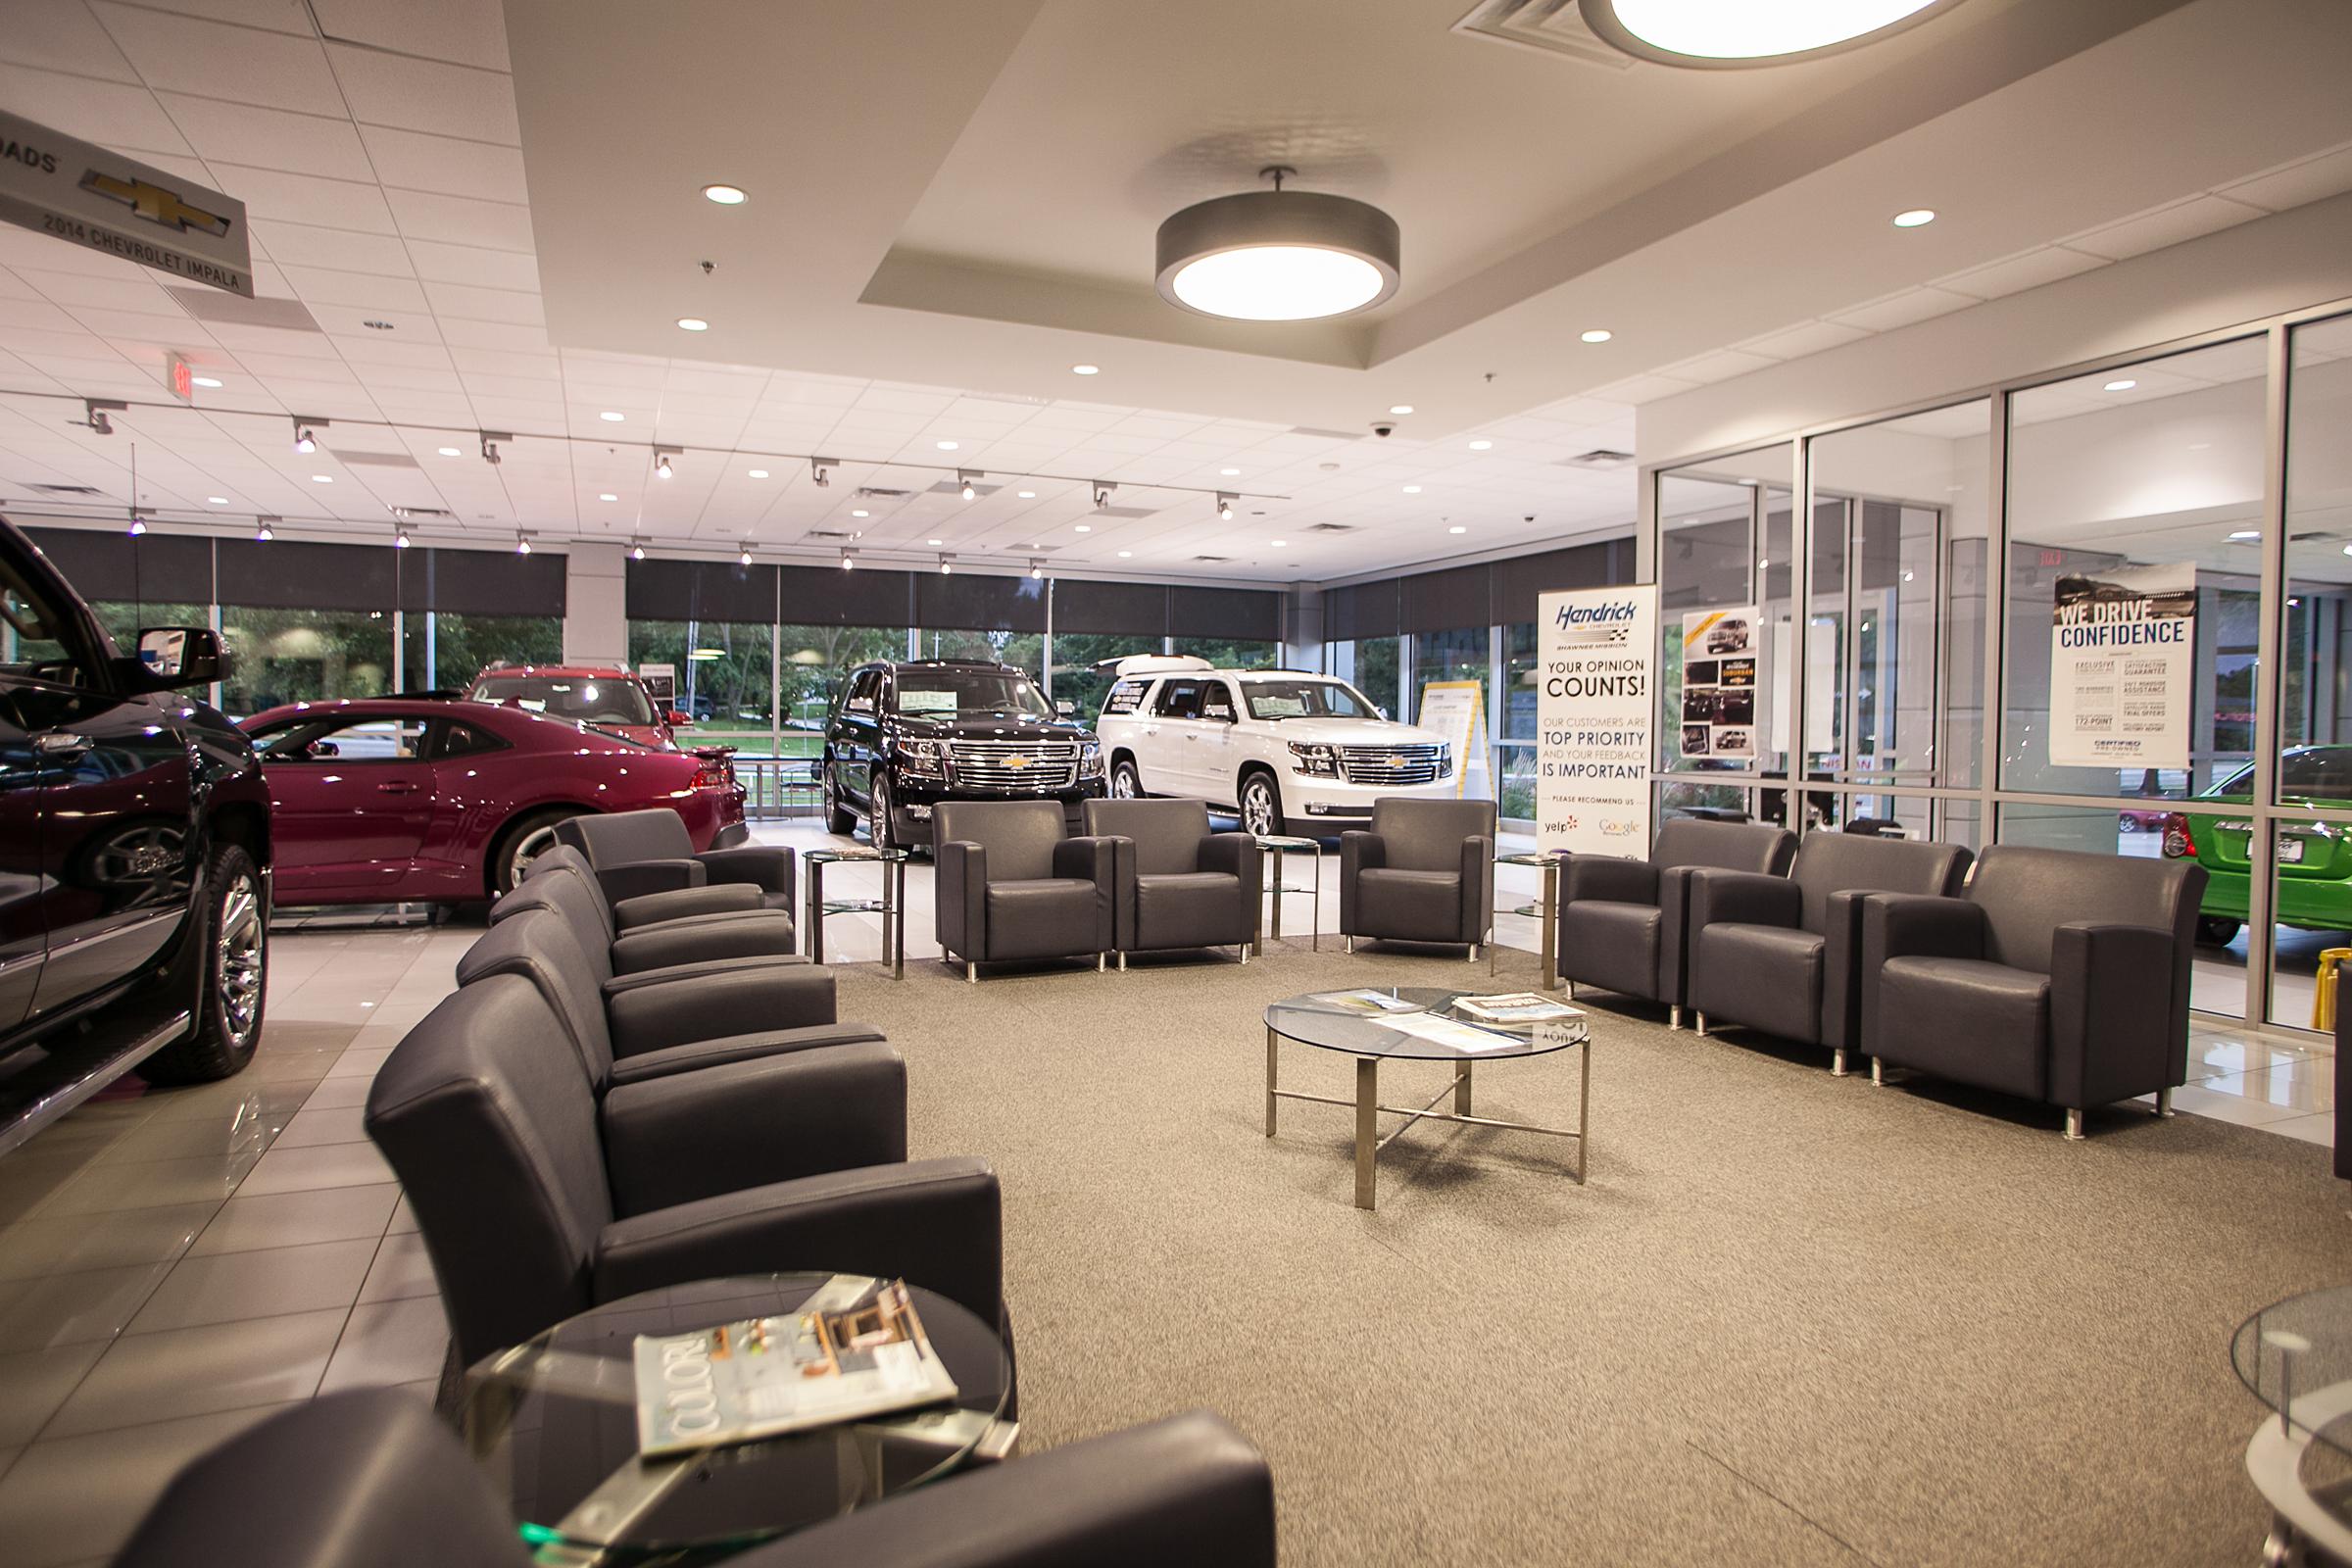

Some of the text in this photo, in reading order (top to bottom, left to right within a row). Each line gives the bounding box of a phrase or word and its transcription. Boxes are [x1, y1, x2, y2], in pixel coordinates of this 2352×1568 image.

[0, 138, 57, 174] ADS
[43, 214, 240, 290] 2014 CHEVROLET IMPALA
[1555, 601, 1638, 630] Hendrick
[2060, 598, 2154, 625] WE DRIVE
[2061, 620, 2184, 648] CONFIDENCE
[1548, 659, 1644, 673] YOUR OPINION
[1546, 675, 1644, 698] COUNTS!
[1543, 717, 1645, 727] OUR CUSTOMERS ARE
[1544, 731, 1644, 746] TOP PRIORITY
[1543, 749, 1645, 760] AND YOUR FEEDBACK
[1543, 762, 1645, 779] IS IMPORTANT
[1577, 796, 1623, 805] RECOMMEND
[1544, 818, 1641, 837] yelp Google
